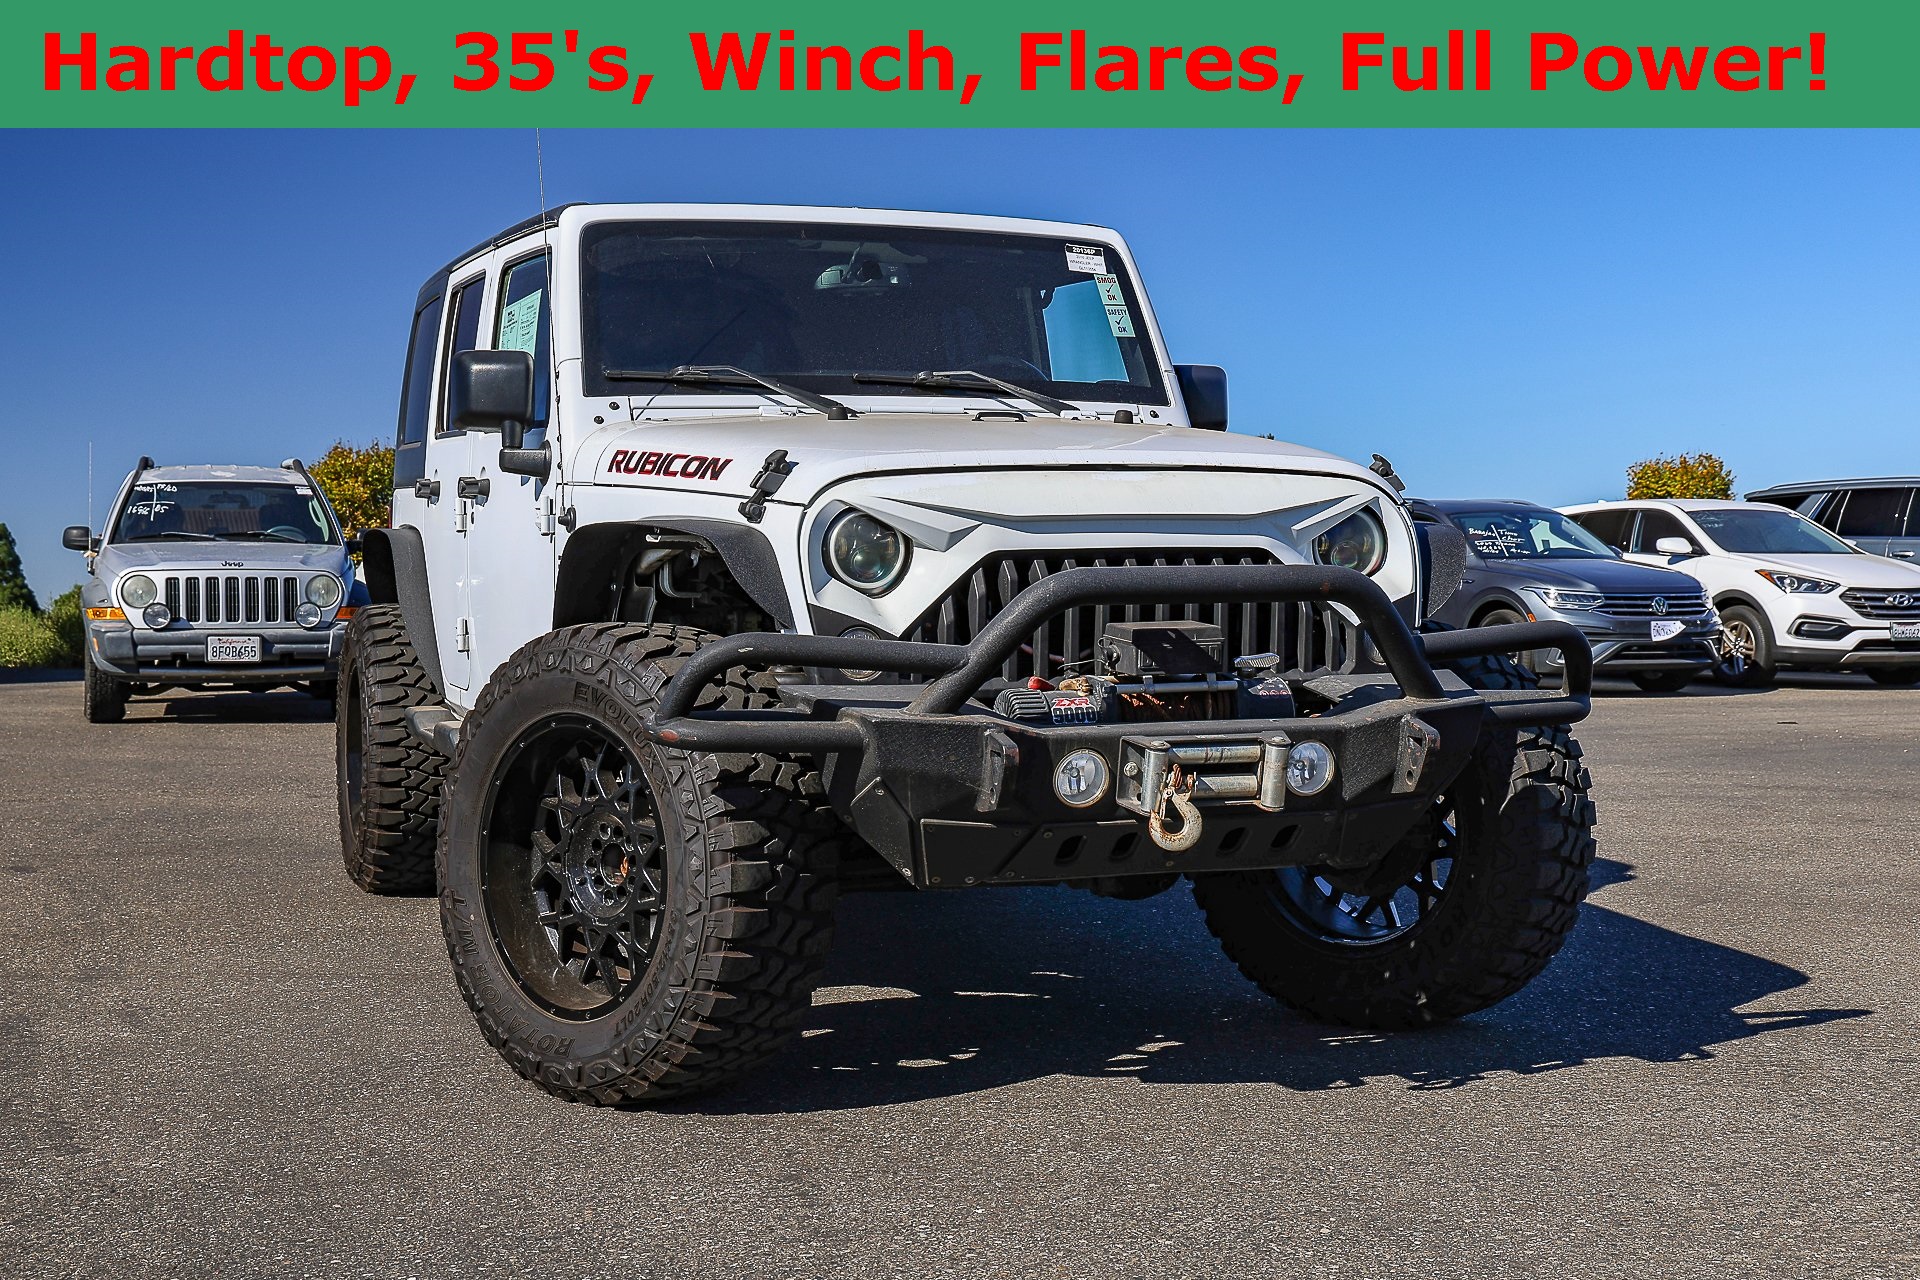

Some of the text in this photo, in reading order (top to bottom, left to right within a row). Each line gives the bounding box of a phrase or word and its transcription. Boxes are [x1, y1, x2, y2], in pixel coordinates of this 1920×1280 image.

[1096, 276, 1117, 284] SMOG
[1106, 308, 1127, 316] SAFETY
[1117, 325, 1128, 333] OK
[607, 449, 733, 481] RUBICON
[220, 560, 244, 568] Jeep
[211, 645, 257, 658] 8FQB655
[469, 962, 576, 1058] ROTATOR
